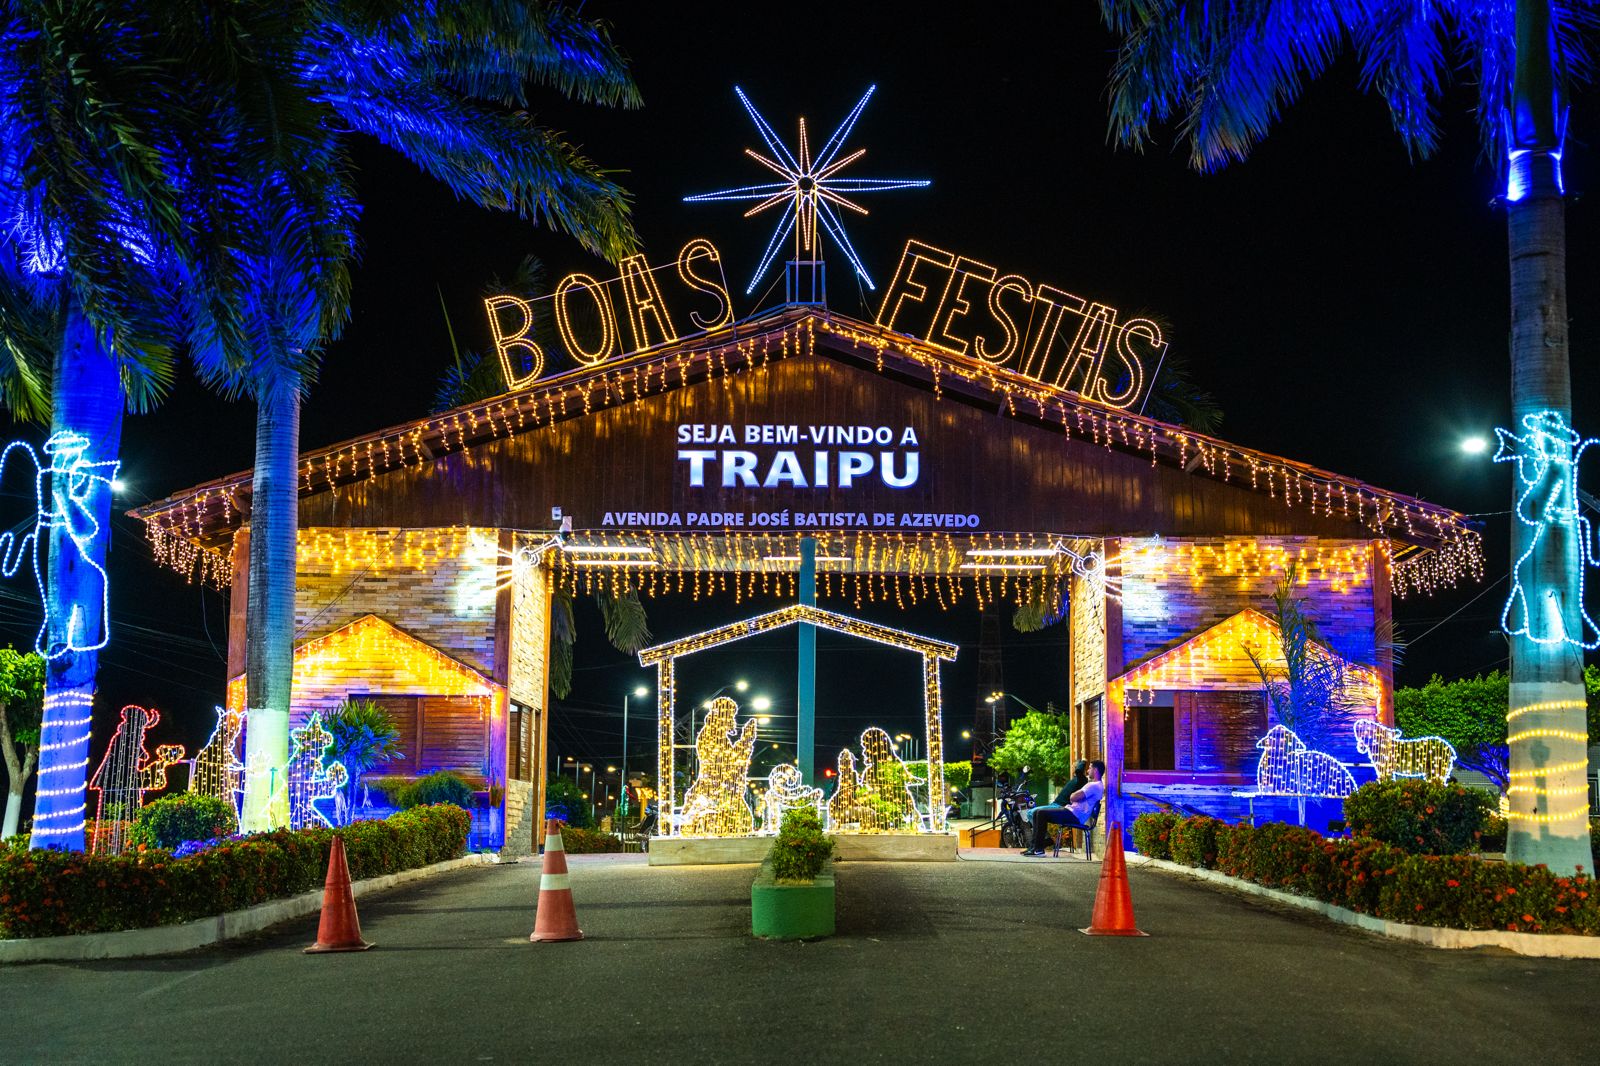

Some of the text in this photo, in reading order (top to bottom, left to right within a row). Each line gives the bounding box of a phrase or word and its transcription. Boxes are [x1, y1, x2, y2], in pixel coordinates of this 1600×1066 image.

[484, 238, 1164, 409] BOAS FESTAS
[677, 423, 919, 445] SEJA BEM-VINDO A
[677, 450, 921, 489] TRAIPU
[602, 508, 980, 528] AVENIDA PADRE JOSÉ BATISTA DE AZEVEDO
